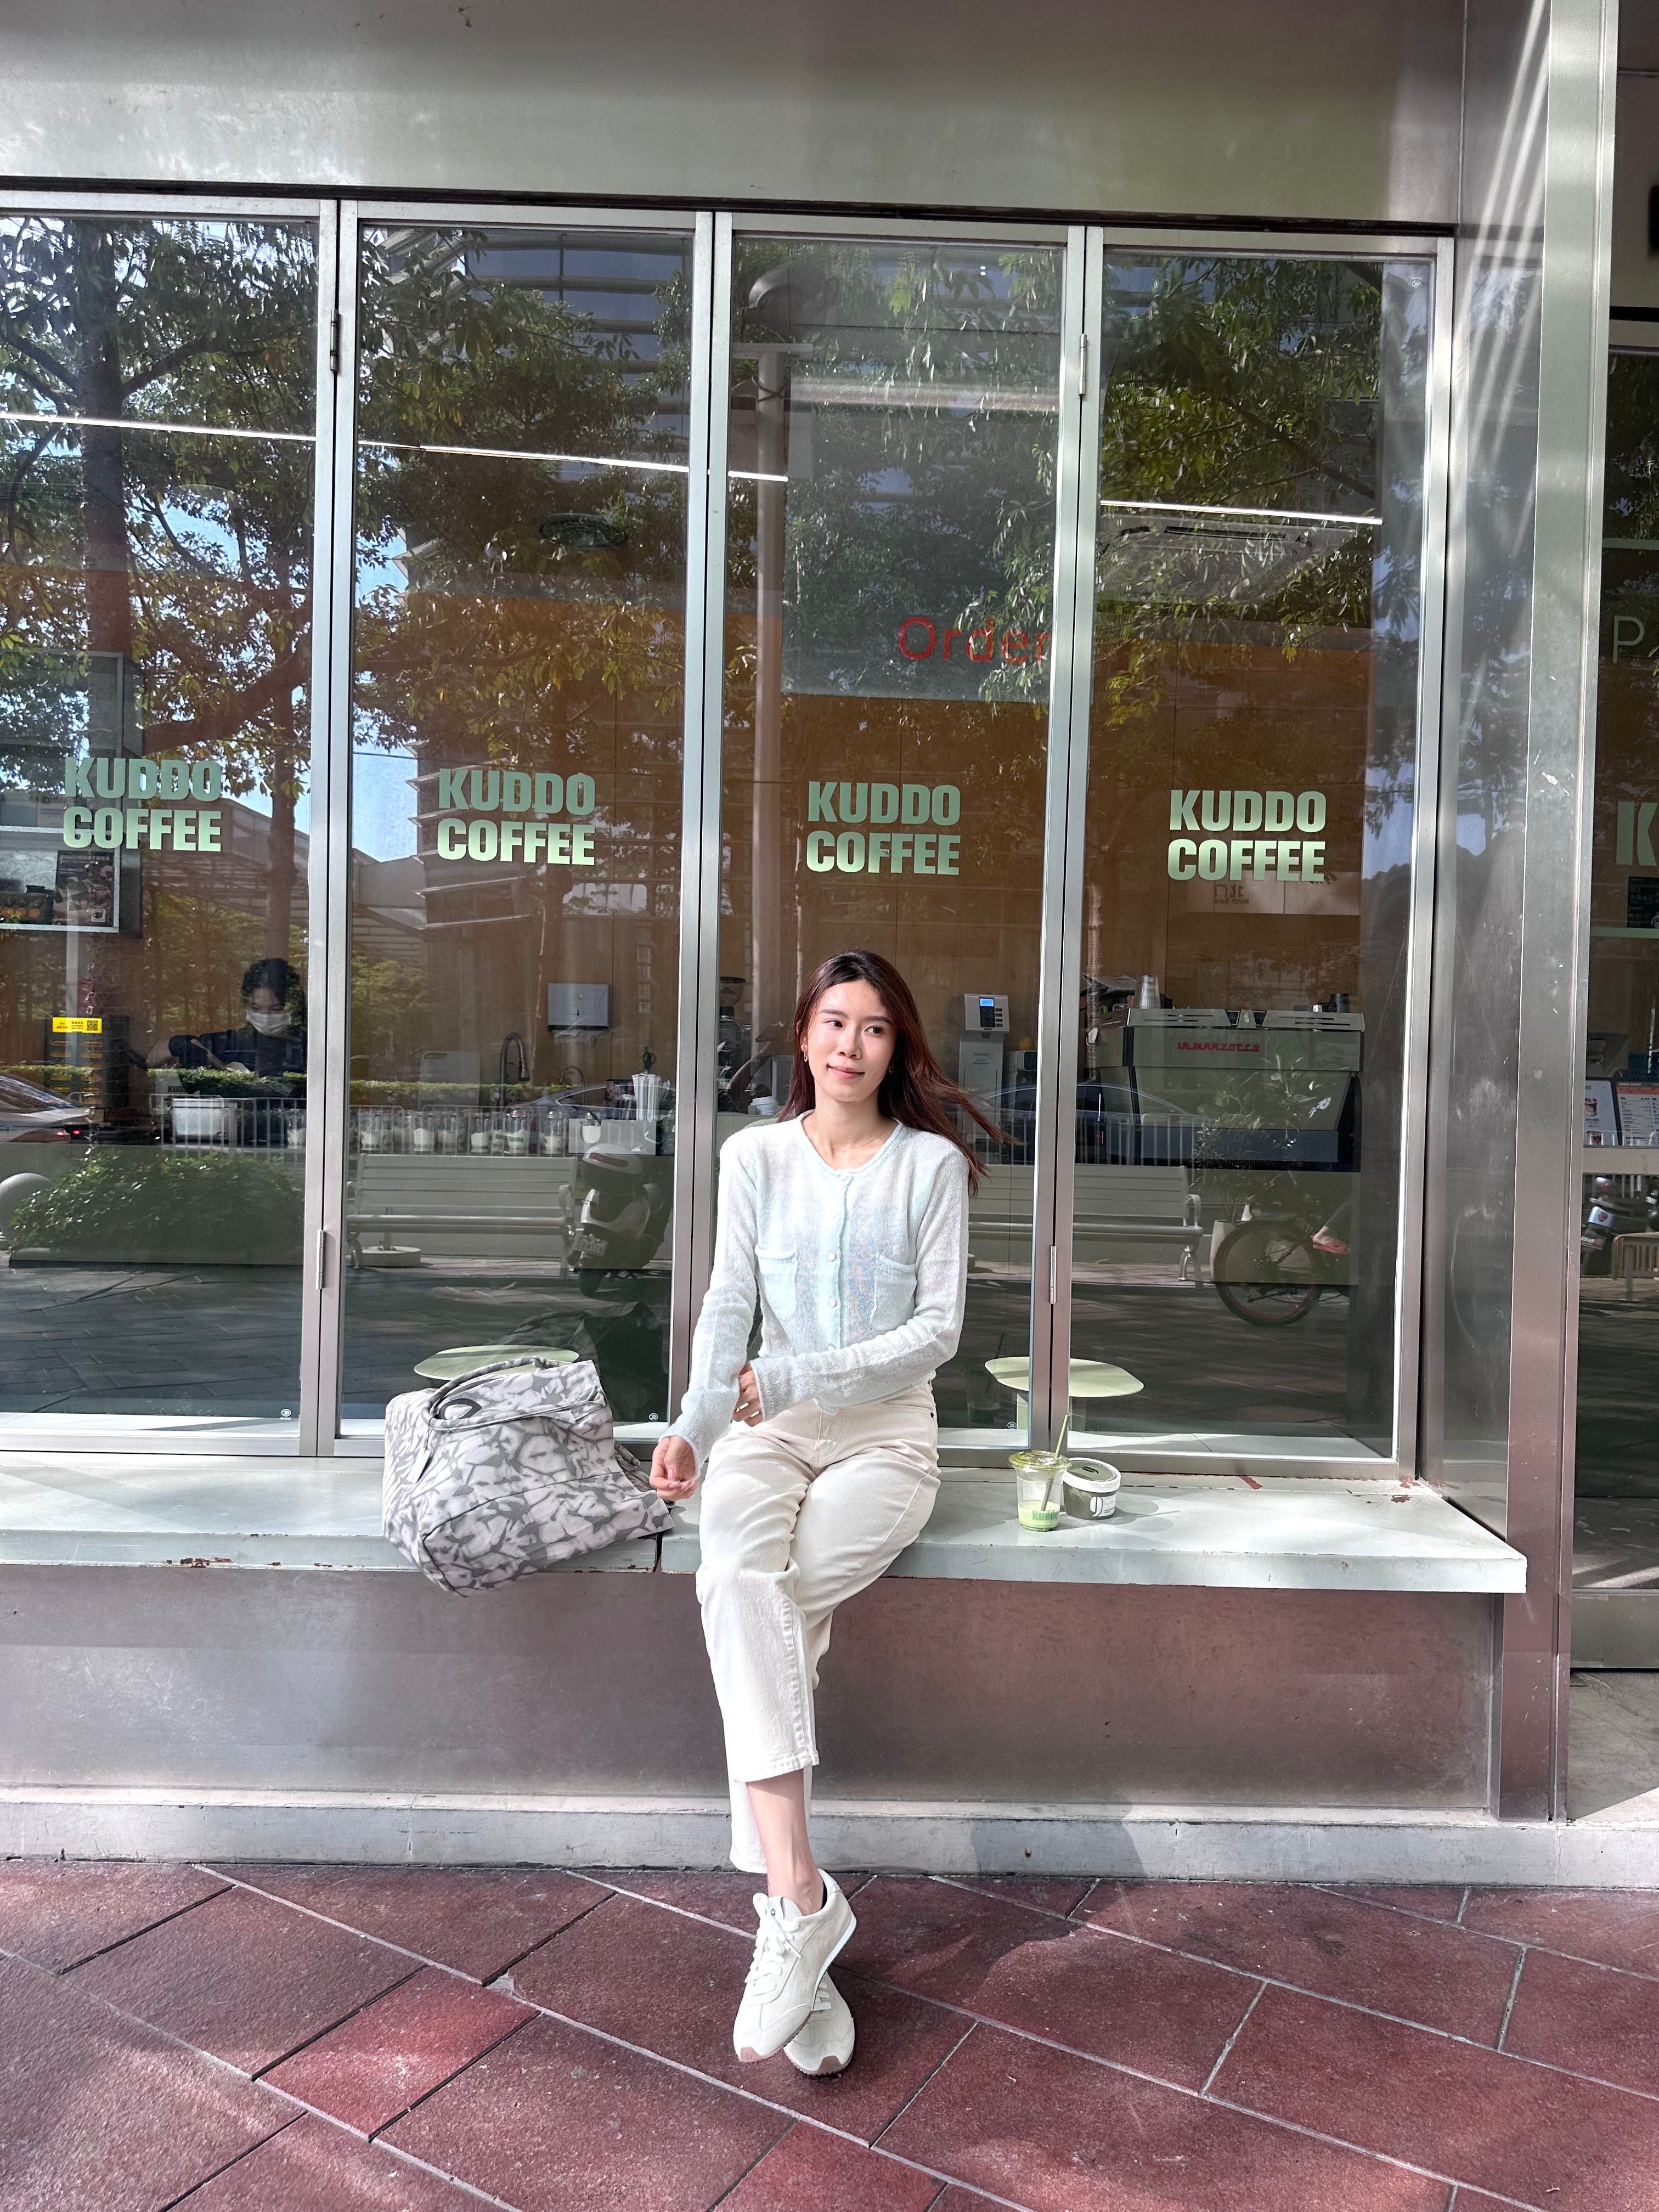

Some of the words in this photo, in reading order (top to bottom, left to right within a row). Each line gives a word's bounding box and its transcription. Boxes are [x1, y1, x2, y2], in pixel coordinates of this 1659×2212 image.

[898, 616, 1052, 665] Order
[64, 756, 222, 803] KUDDO
[438, 767, 596, 816] KUDDO
[808, 780, 961, 826] KUDDO
[1169, 789, 1327, 833] KUDDO
[63, 806, 222, 852] COFFEE
[437, 817, 596, 866] COFFEE
[806, 830, 961, 876] COFFEE
[1167, 838, 1326, 882] COFFEE
